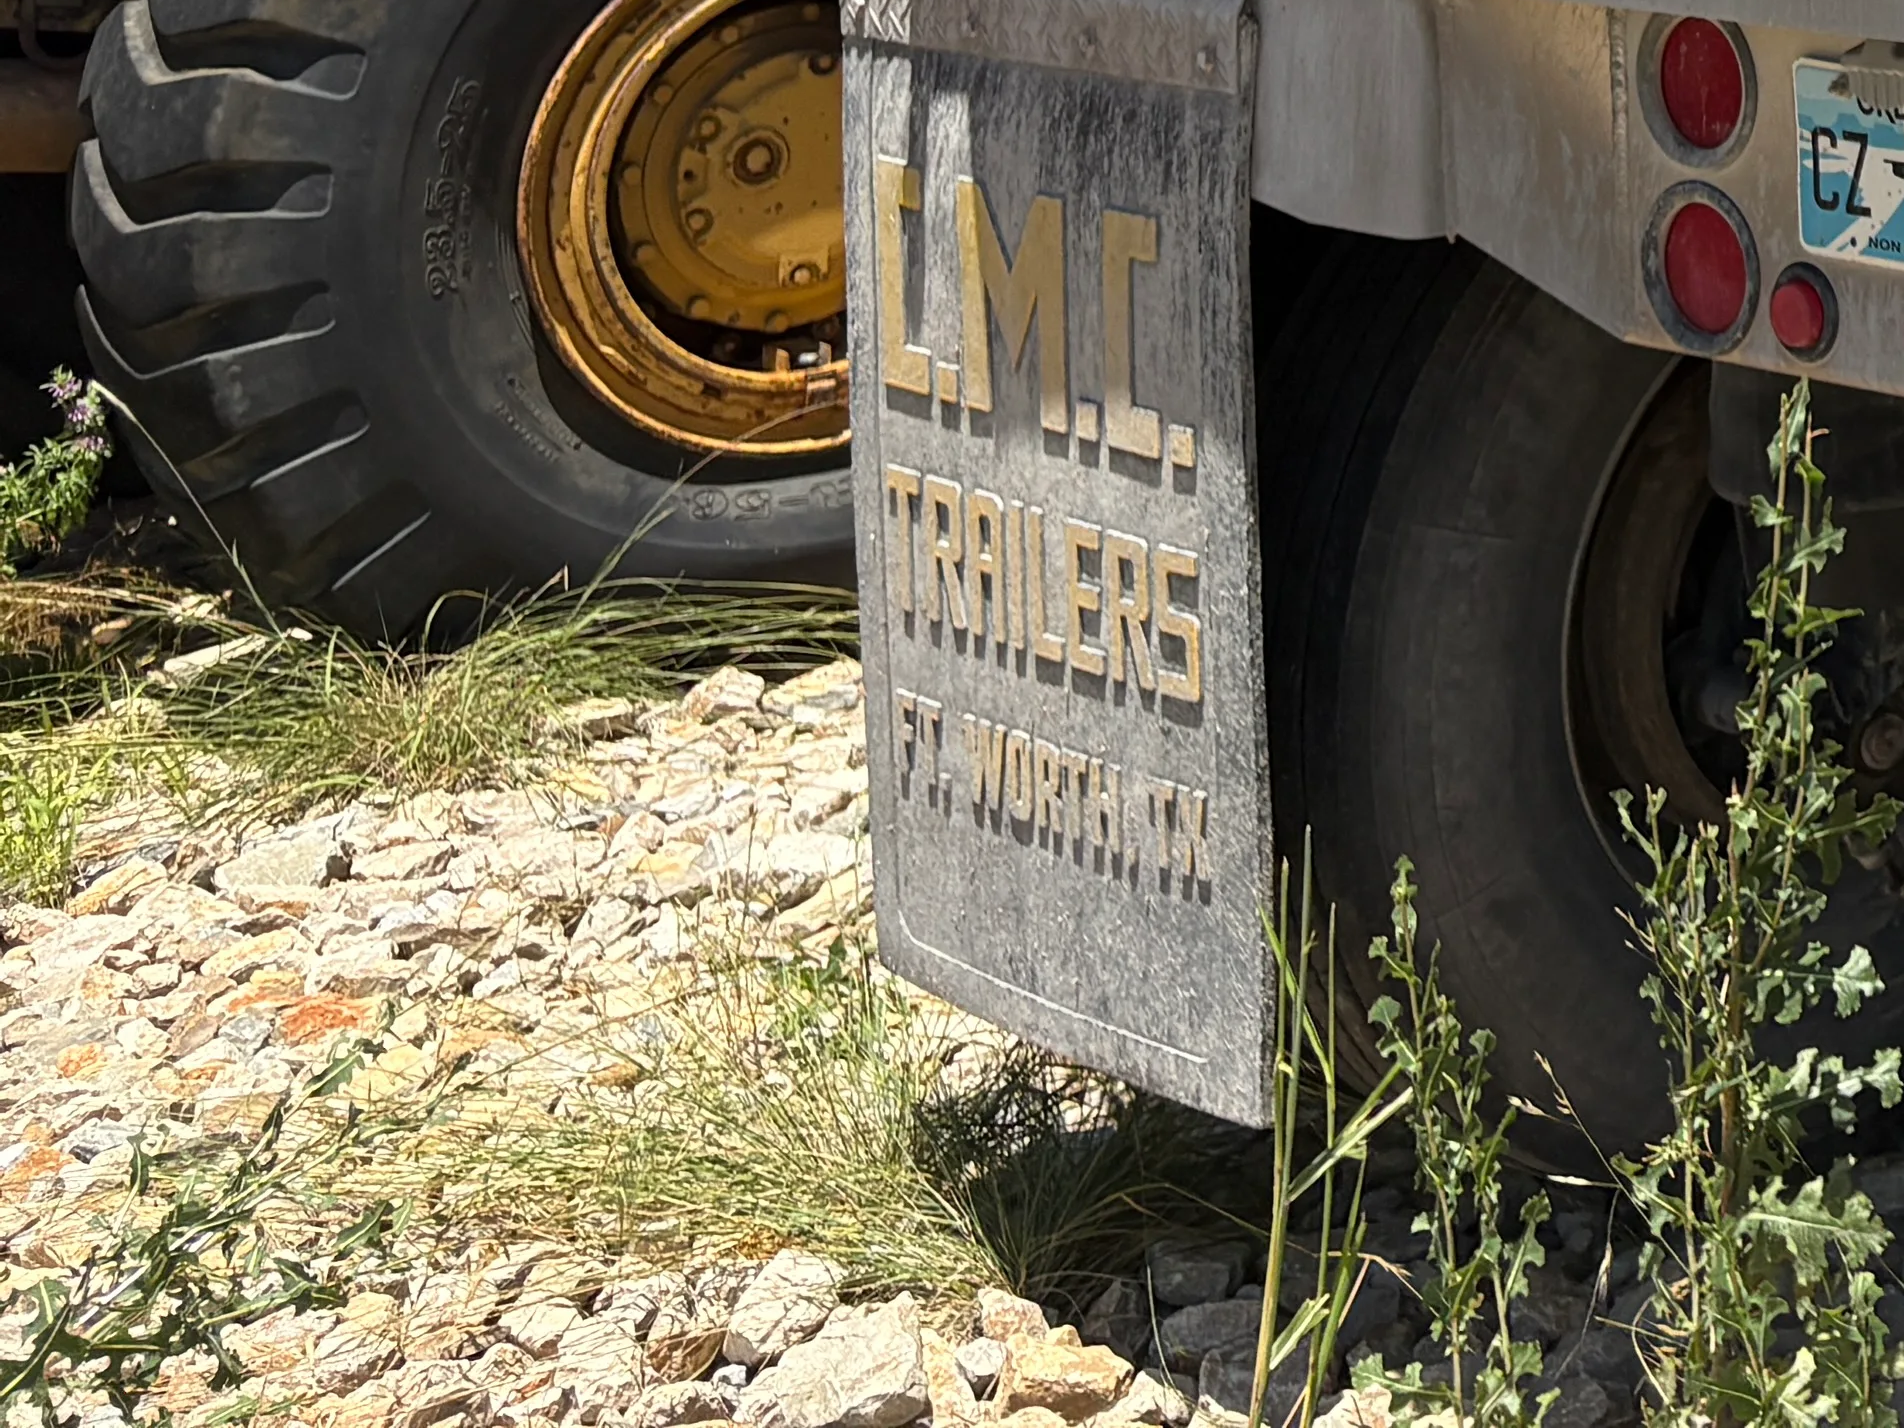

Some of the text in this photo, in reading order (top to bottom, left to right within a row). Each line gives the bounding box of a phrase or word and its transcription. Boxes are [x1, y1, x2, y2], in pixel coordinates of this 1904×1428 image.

[1811, 127, 1872, 219] CZ
[1868, 235, 1900, 254] NON
[886, 462, 1201, 703] TRAILERS
